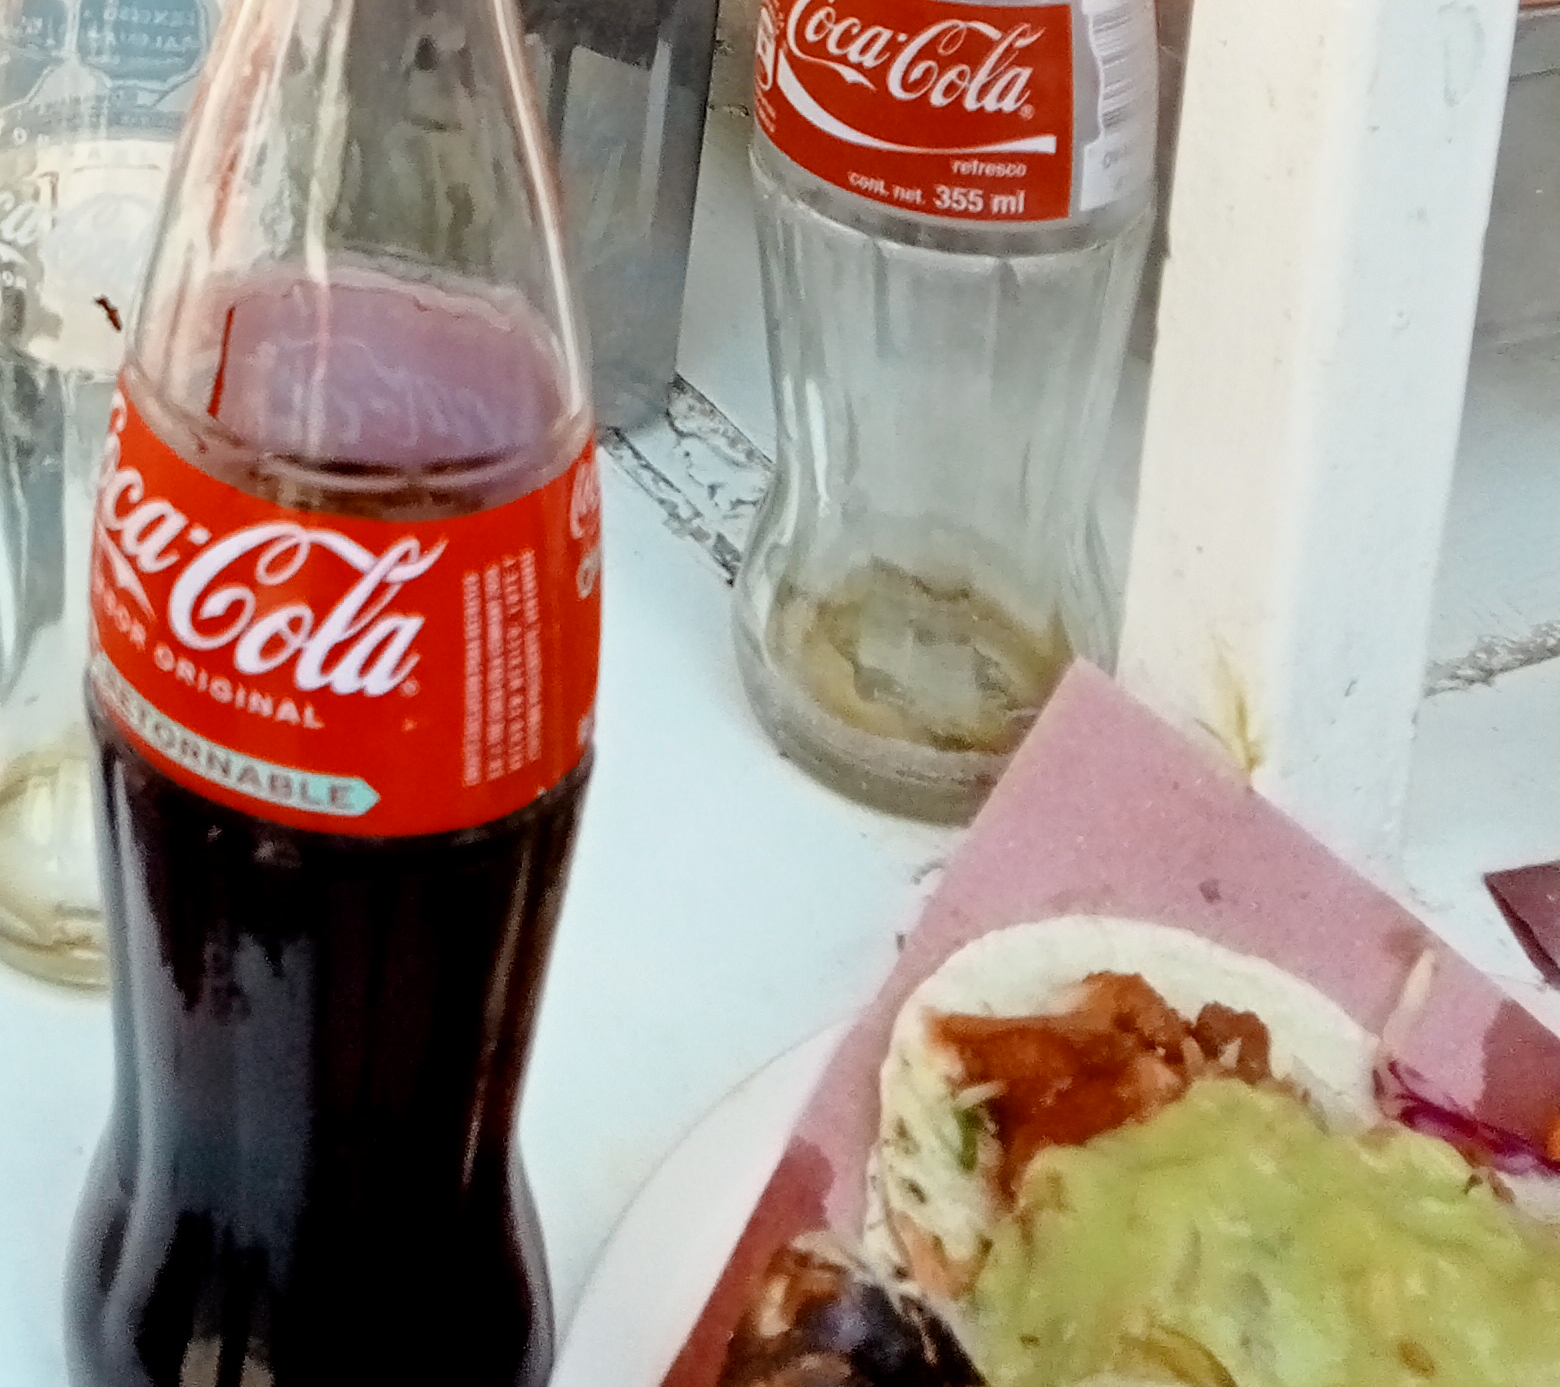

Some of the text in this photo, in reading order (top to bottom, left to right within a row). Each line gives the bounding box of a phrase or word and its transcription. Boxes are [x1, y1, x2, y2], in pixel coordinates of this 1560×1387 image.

[951, 158, 1028, 179] refresco
[933, 183, 984, 213] 355
[990, 190, 1026, 215] ml
[154, 642, 325, 730] ORIGINAL
